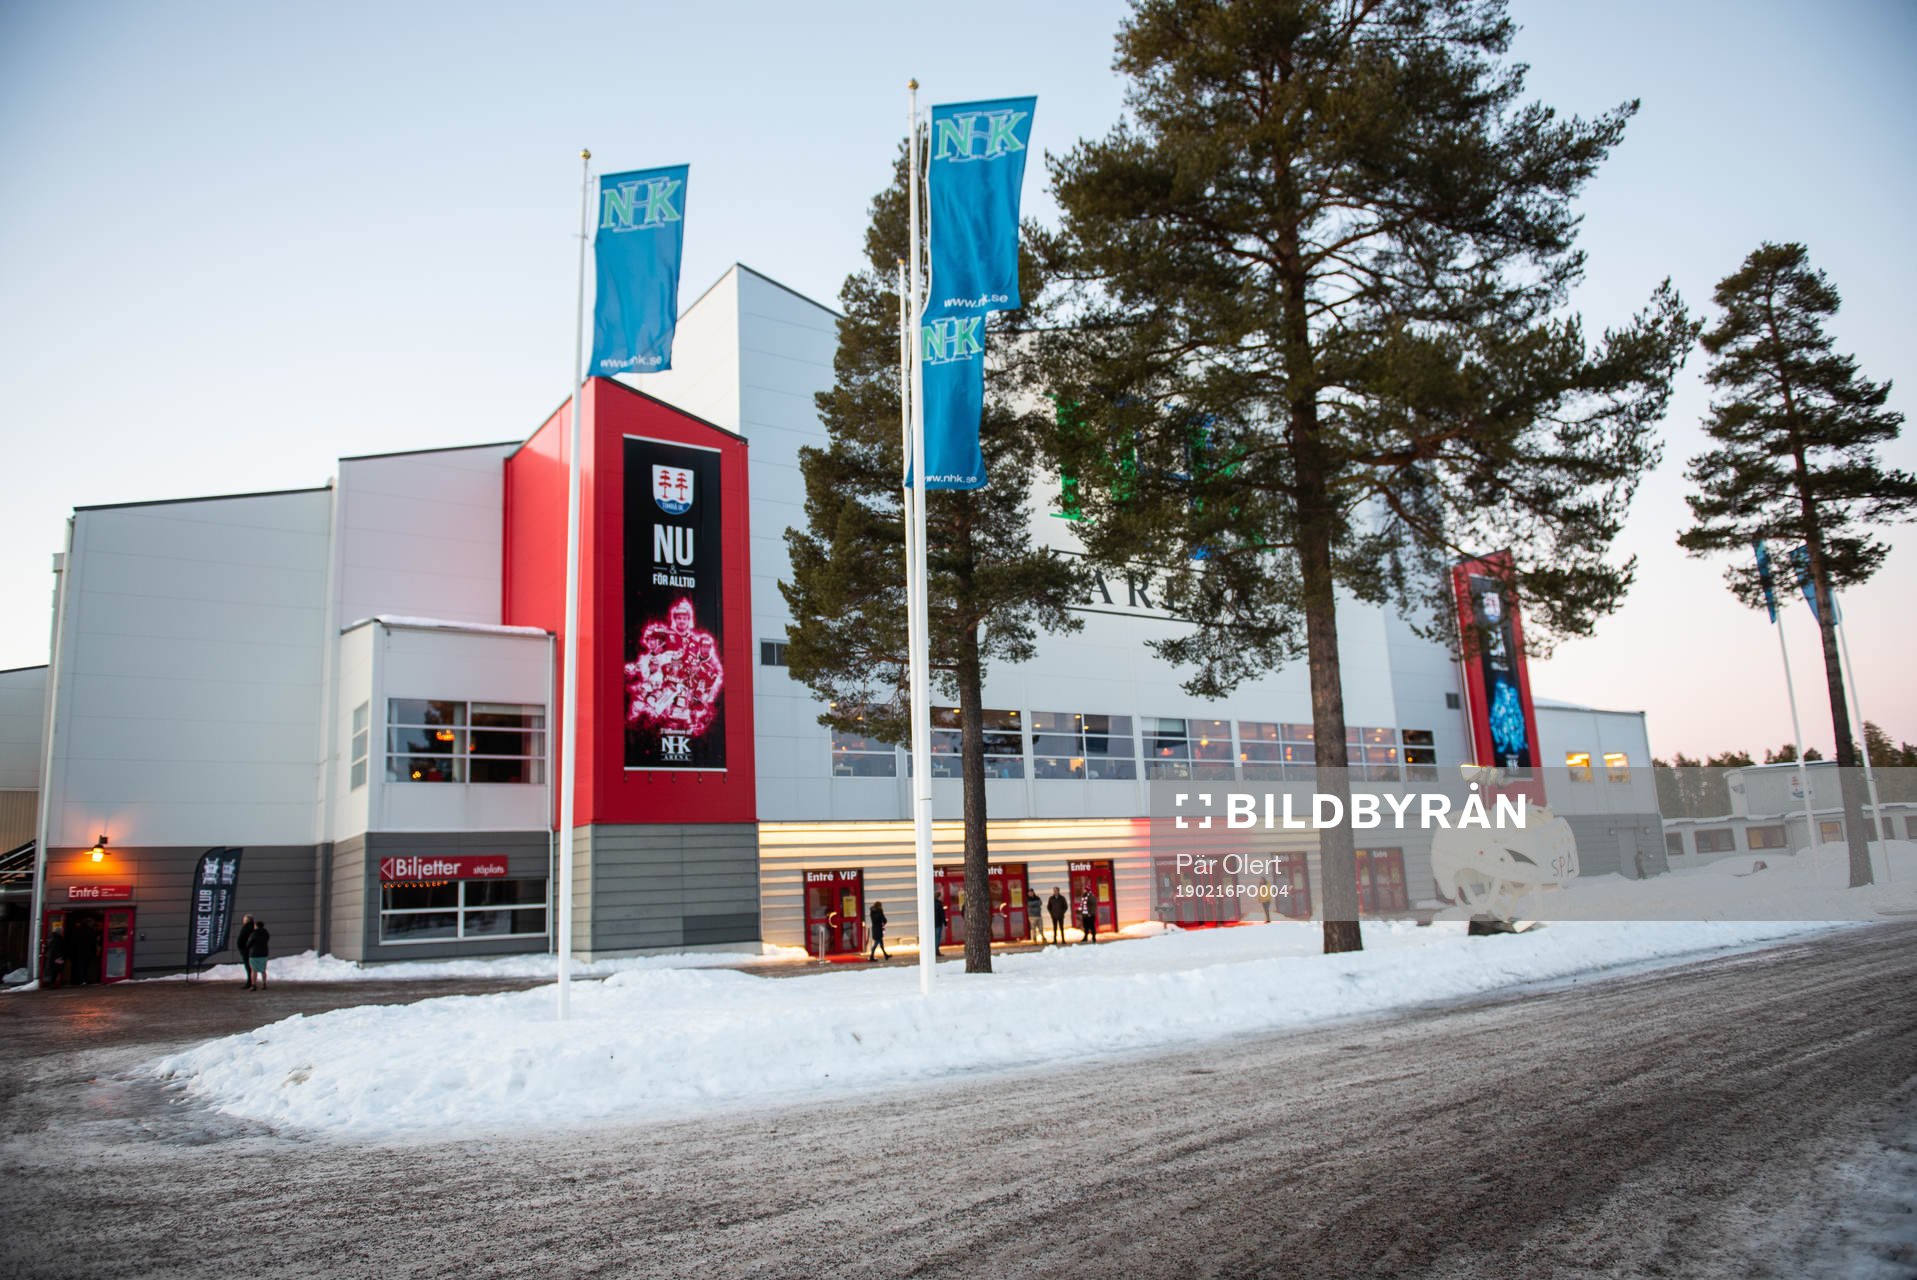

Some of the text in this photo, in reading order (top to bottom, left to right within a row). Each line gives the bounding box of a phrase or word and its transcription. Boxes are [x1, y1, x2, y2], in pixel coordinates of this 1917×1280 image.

[934, 109, 1028, 162] NHK
[600, 176, 682, 232] NHK
[944, 293, 1008, 308] www.nk.se
[921, 316, 983, 365] NHK
[925, 474, 977, 483] ww.nhk.se
[653, 523, 694, 566] NU
[653, 572, 696, 589] FÖR ALLTID
[661, 735, 691, 754] NHK
[396, 856, 462, 880] Biljetter
[807, 870, 857, 882] Entré VIP
[988, 865, 1003, 875] ntré
[69, 886, 99, 898] Entré
[195, 889, 213, 954] RINKSIDE CLUB
